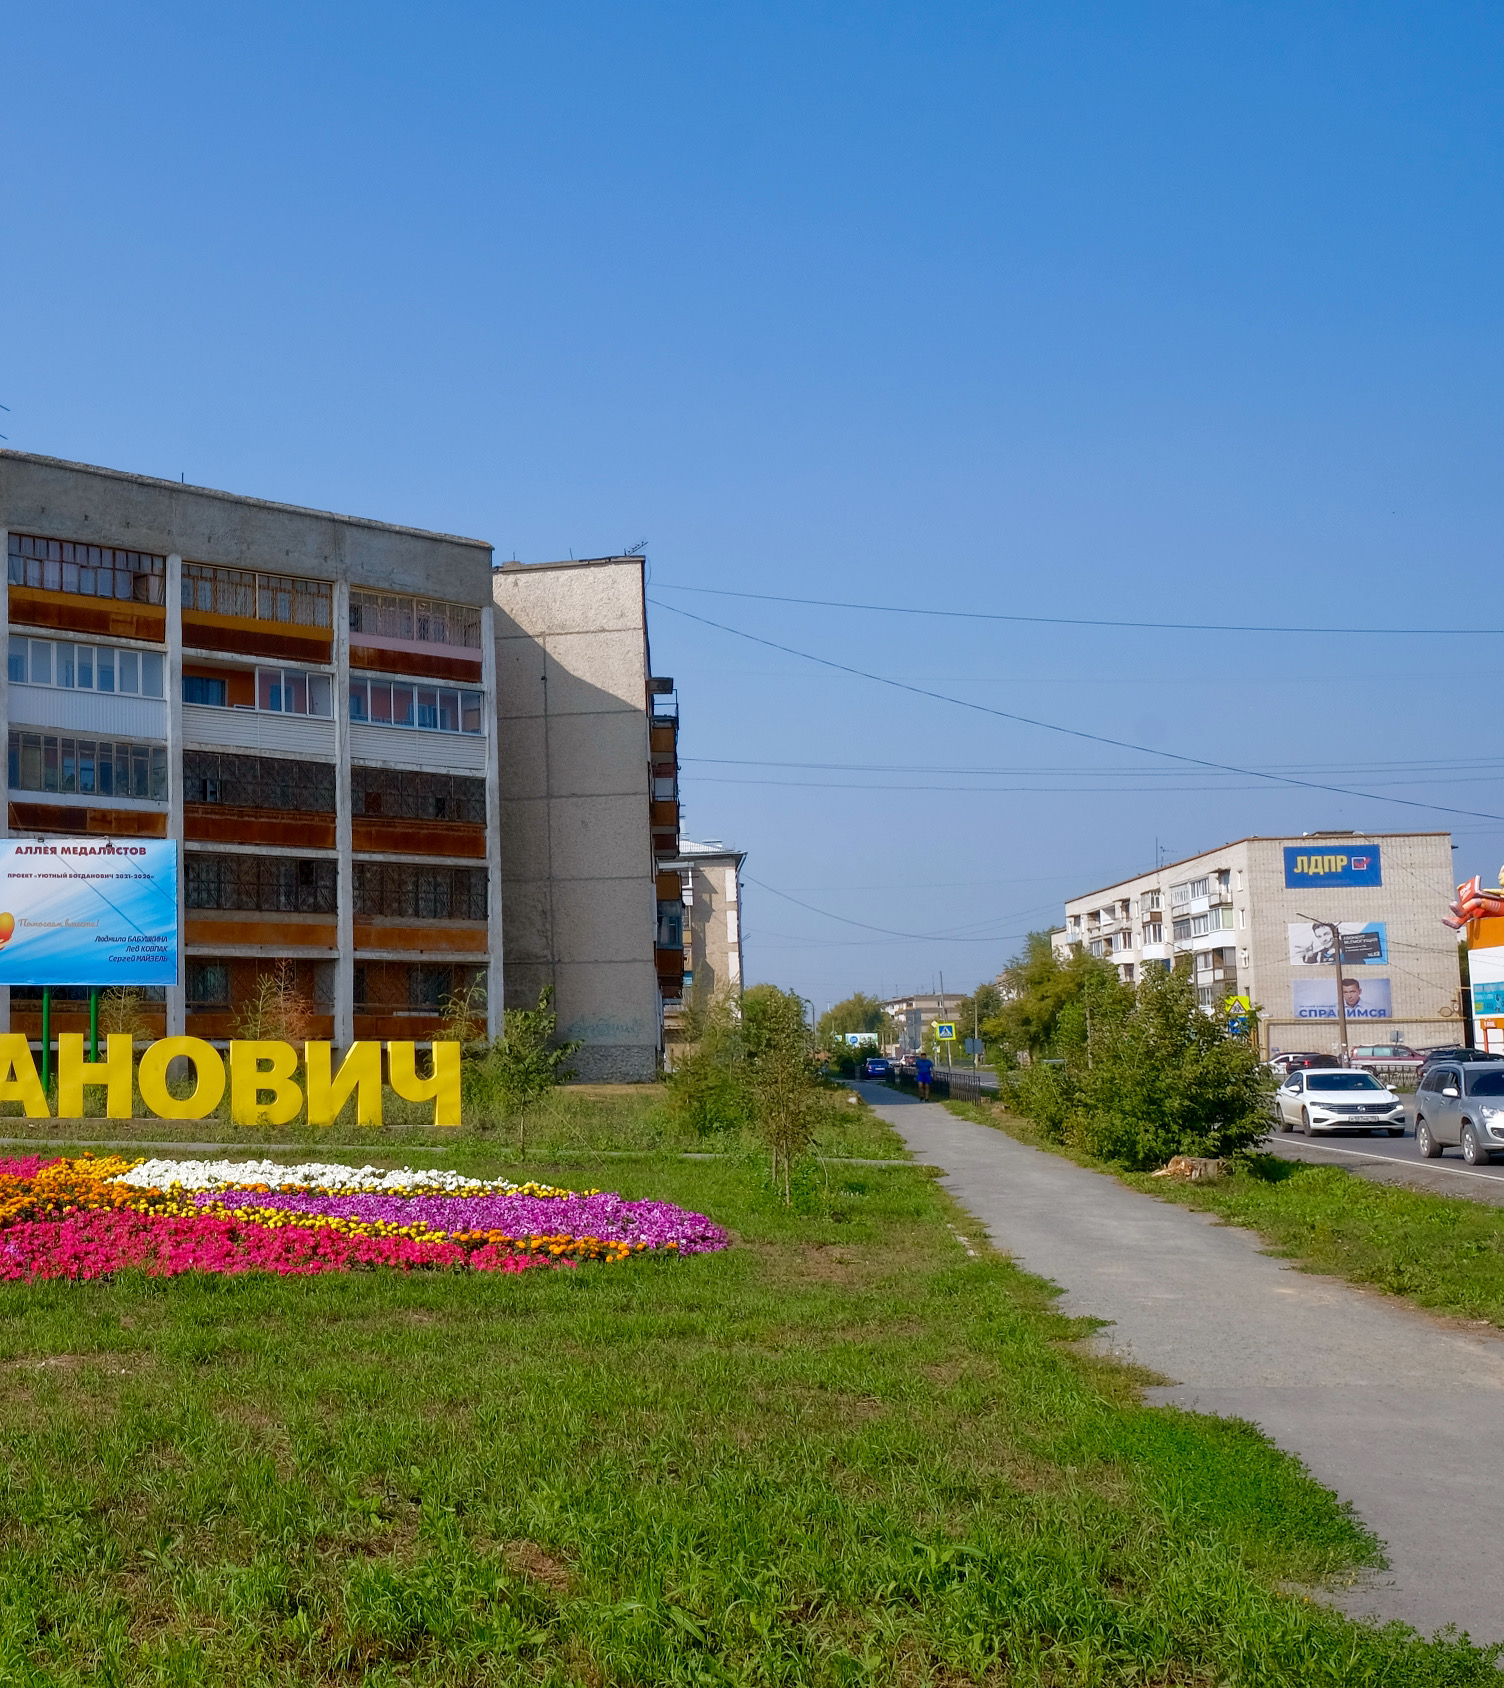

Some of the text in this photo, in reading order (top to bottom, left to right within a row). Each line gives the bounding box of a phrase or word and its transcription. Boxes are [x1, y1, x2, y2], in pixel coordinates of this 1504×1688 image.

[15, 846, 147, 857] АЛЛЕЯ МЕДАЛИСТОВ
[1293, 855, 1348, 875] ЛДПР
[18, 918, 100, 928] Помогаем вместе!
[95, 935, 169, 943] Людмила БАБУШКИНА
[140, 945, 169, 953] КОВПАК
[108, 953, 169, 964] Сергей МАЙЗЕЛЬ
[1299, 1008, 1387, 1018] СПРАИМСЯ
